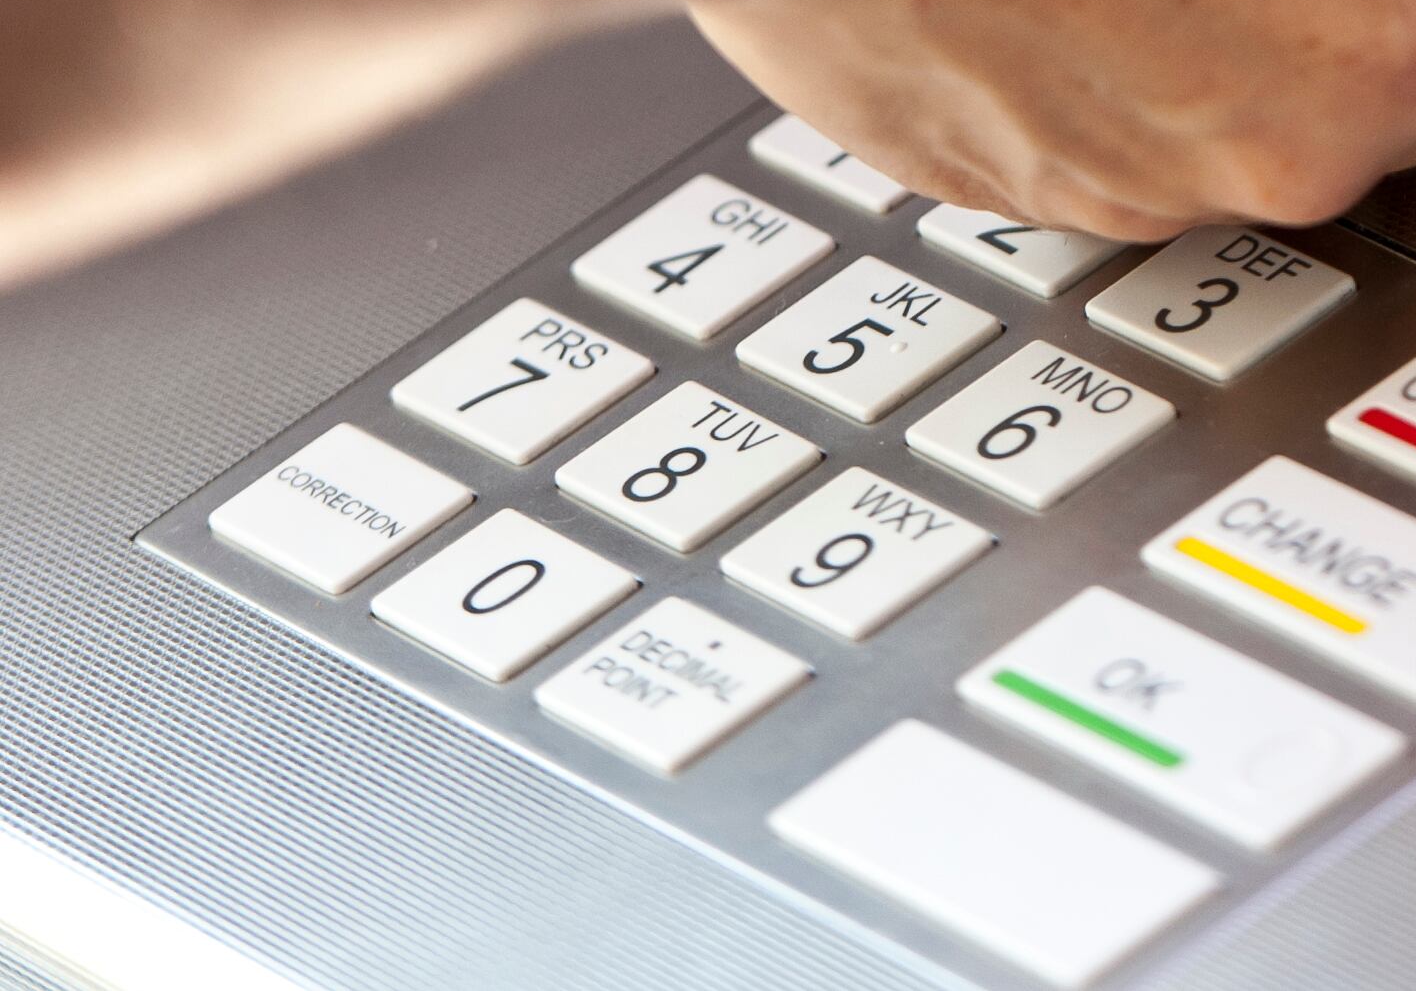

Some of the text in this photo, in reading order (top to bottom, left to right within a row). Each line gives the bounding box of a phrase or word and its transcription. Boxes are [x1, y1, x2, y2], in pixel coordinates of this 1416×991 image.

[710, 198, 789, 247] GHI
[646, 243, 727, 293] 4
[1213, 234, 1312, 283] DEF
[869, 282, 943, 327] JKL
[1155, 277, 1240, 334] 3
[520, 318, 610, 372] PRS
[802, 318, 894, 376] 5
[455, 358, 549, 412] 7
[1031, 355, 1133, 415] MNO
[690, 400, 779, 453] TUV
[977, 405, 1062, 460] 6
[275, 464, 406, 539] CORRECTION
[621, 447, 708, 503] 8
[851, 484, 955, 540] WXY
[462, 559, 546, 615] 0
[790, 533, 875, 588] 9
[584, 657, 678, 708] POINT
[619, 629, 745, 704] DECIMAL
[1095, 658, 1182, 710] OK
